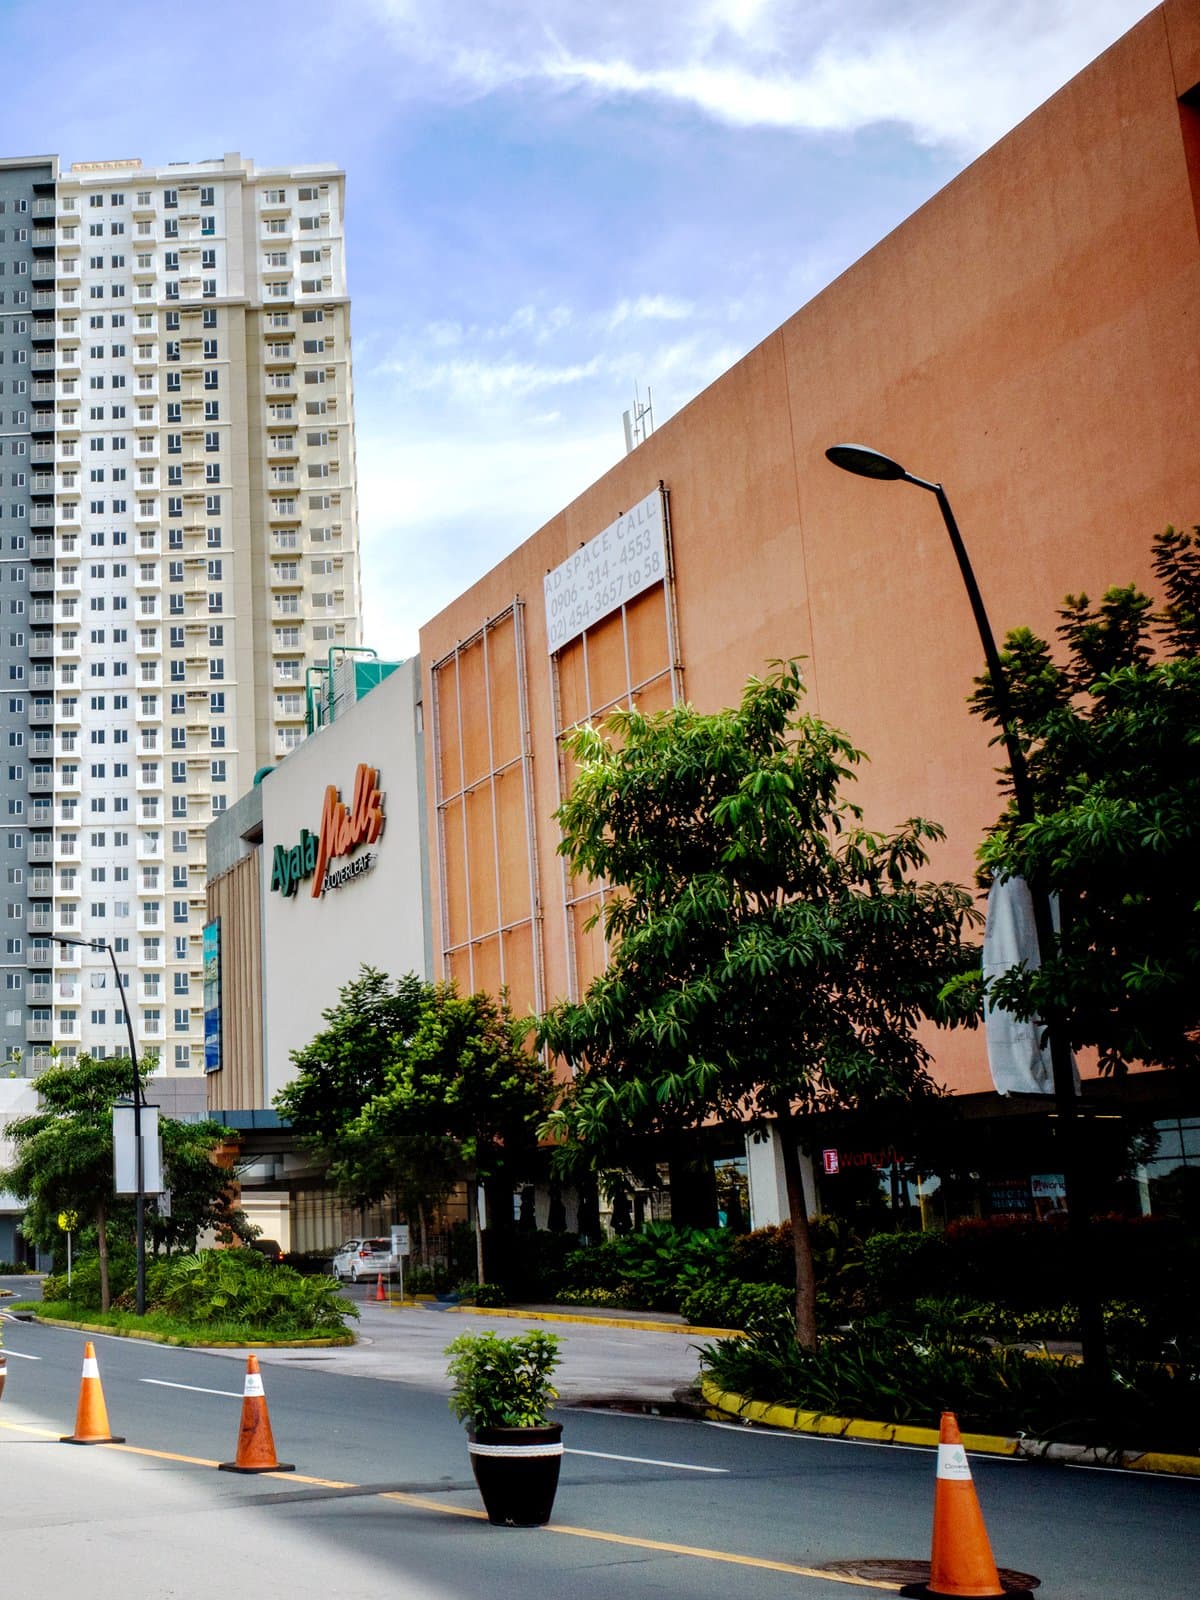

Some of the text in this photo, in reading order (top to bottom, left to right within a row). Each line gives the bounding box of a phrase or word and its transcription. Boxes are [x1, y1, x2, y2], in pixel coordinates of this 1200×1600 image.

[545, 571, 561, 596] AD
[616, 501, 656, 540] CALL:
[628, 569, 641, 589] to
[644, 551, 660, 578] 58
[271, 763, 382, 898] Ayala Malls
